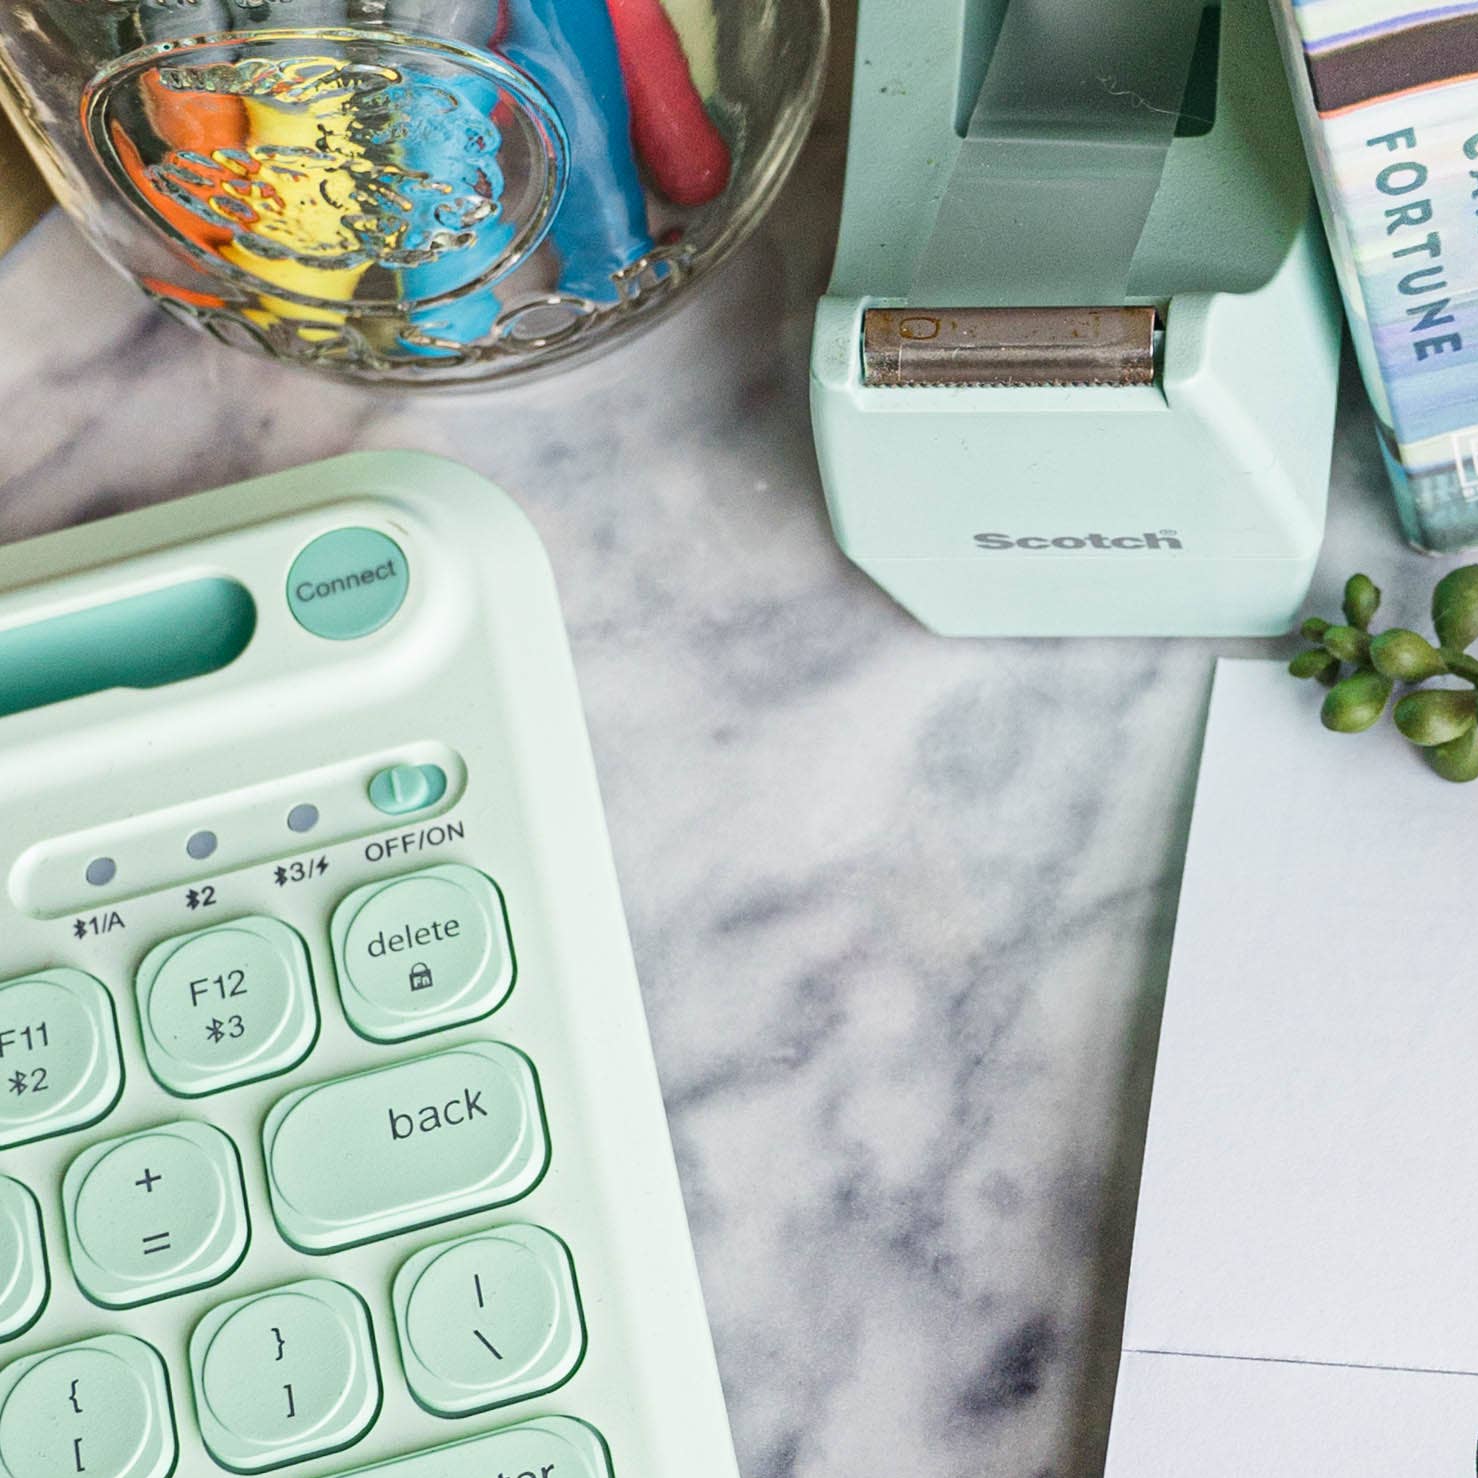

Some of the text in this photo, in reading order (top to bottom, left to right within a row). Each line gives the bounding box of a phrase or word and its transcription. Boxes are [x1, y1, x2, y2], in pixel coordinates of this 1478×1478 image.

[1366, 127, 1463, 361] FORTUNE
[973, 532, 1183, 550] Scotch
[296, 559, 398, 605] Connect
[364, 821, 465, 863] OFF/ON
[367, 919, 460, 958] delete
[189, 969, 248, 1007] F12
[0, 1021, 49, 1058] F11
[388, 1088, 488, 1141] back
